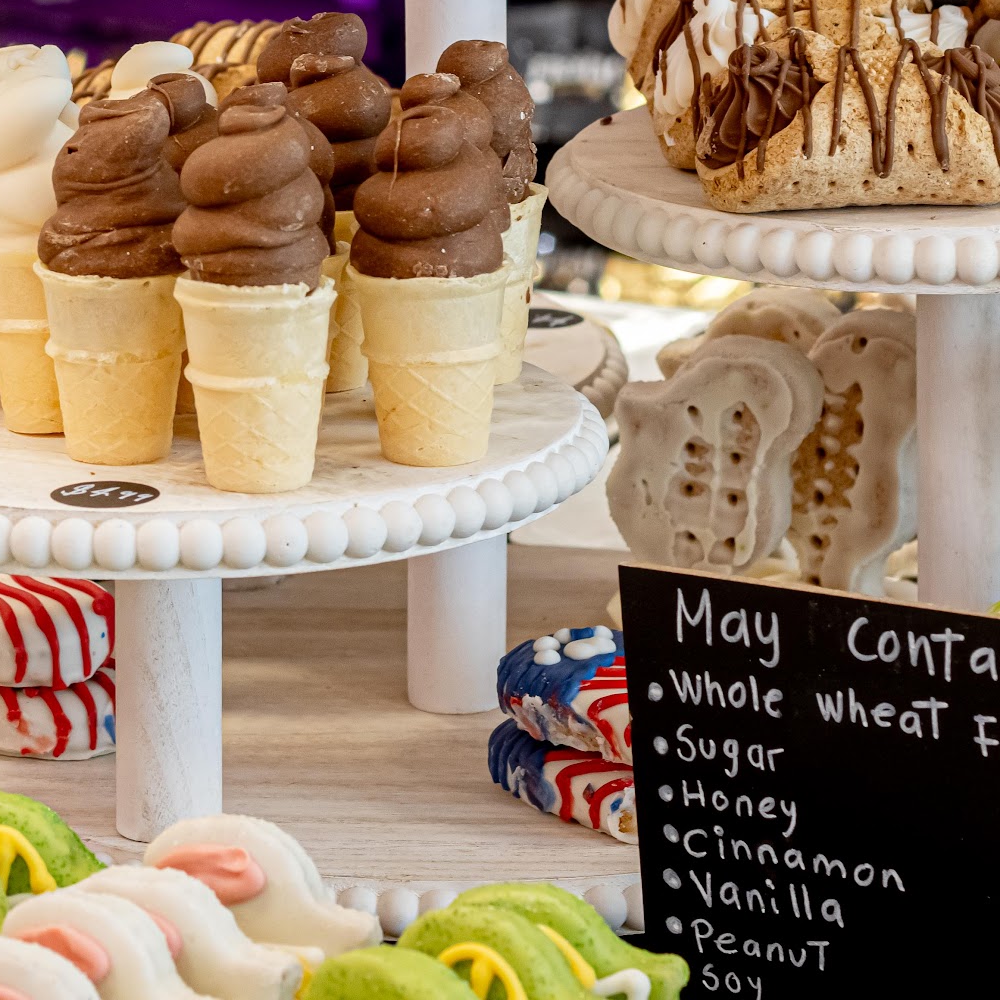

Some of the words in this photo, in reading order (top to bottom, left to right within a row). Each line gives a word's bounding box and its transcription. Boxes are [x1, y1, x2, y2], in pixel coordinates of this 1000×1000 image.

[676, 587, 780, 668] May
[847, 617, 999, 682] Conta
[668, 669, 784, 718] Whole
[676, 723, 785, 778] Sugar
[682, 779, 797, 838] Honey
[683, 825, 906, 893] Cinnamon
[689, 869, 845, 928] Vanilla
